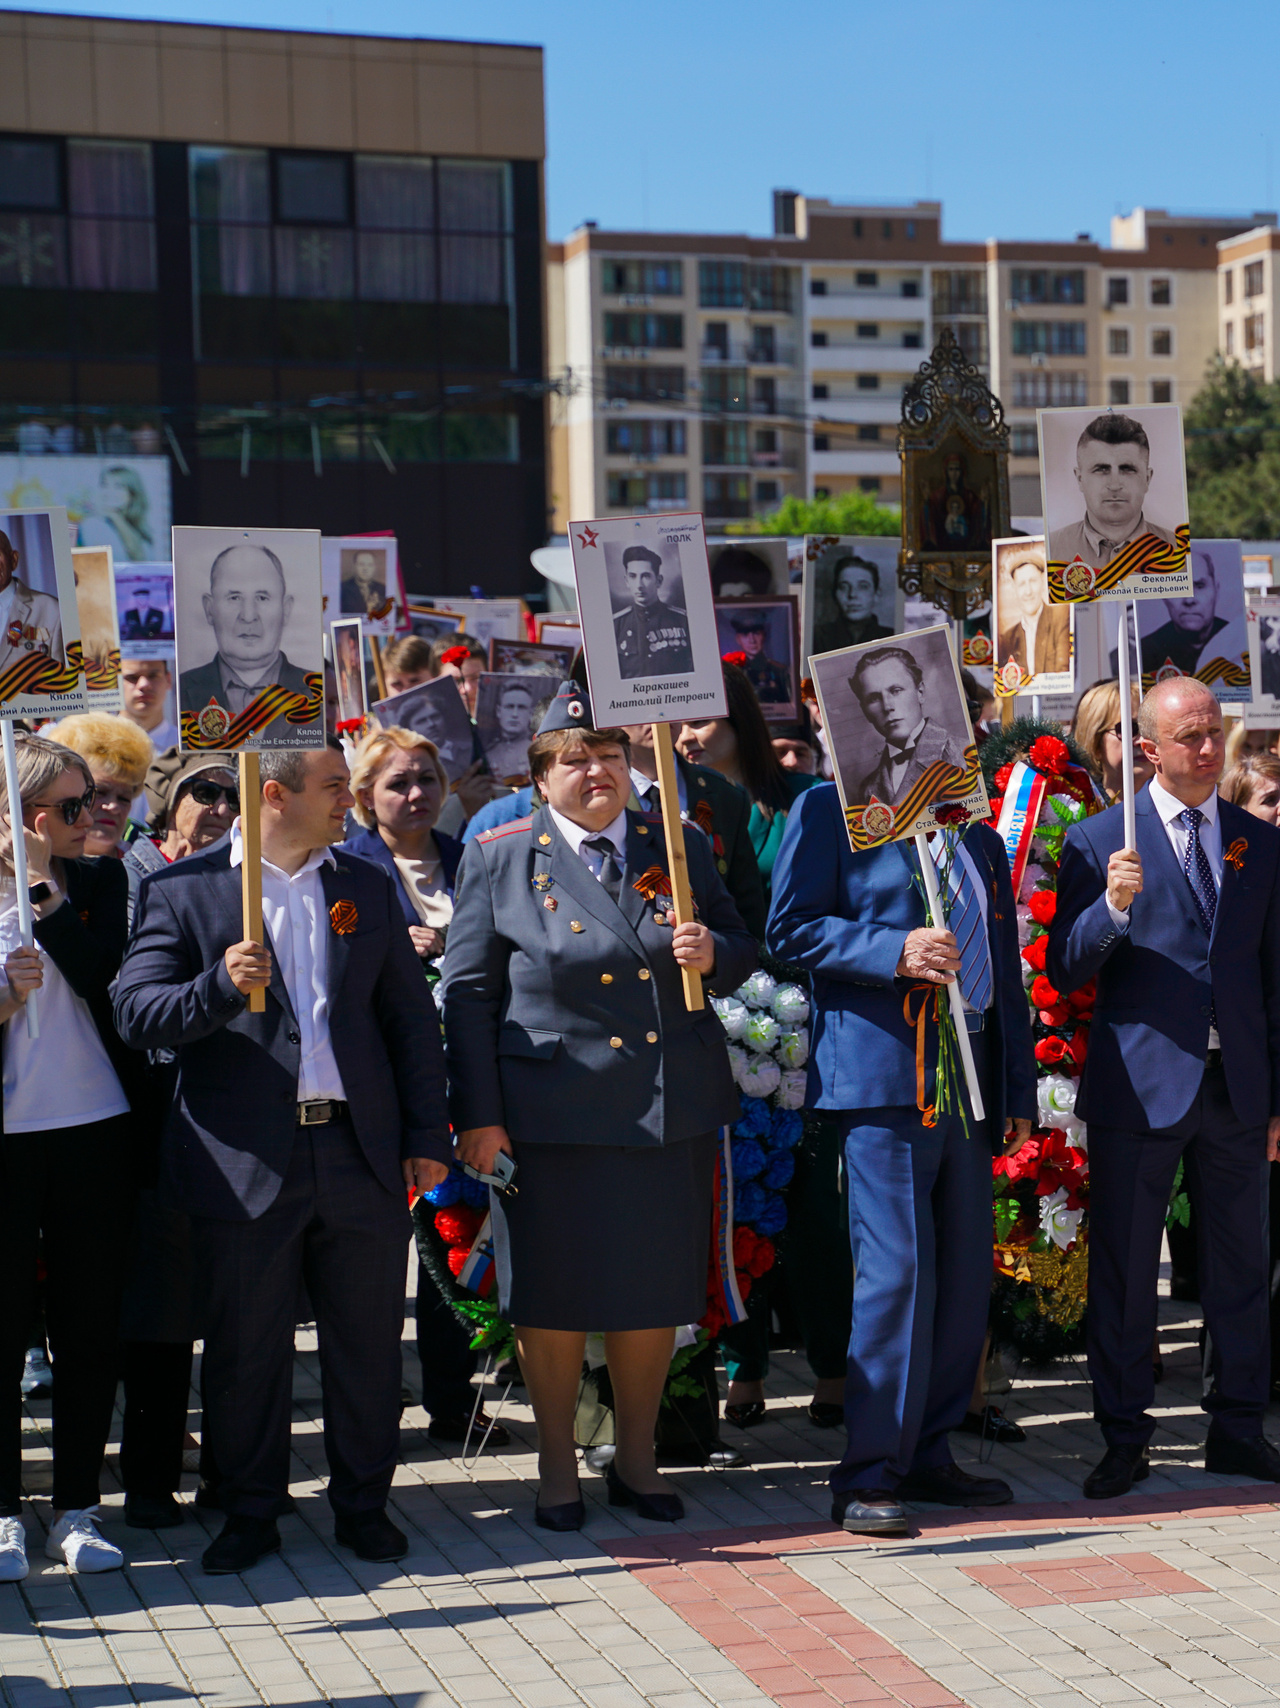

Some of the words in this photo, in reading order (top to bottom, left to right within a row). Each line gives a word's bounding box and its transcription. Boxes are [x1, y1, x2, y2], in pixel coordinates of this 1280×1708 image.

[666, 534, 692, 543] ПОЛК
[1142, 575, 1188, 583] Фекелиди
[1095, 587, 1131, 596] Николай
[1134, 585, 1189, 594] Евстафьевич
[632, 680, 690, 694] Каракашев
[49, 691, 83, 701] Кялов
[609, 695, 662, 710] Анатолий
[664, 691, 715, 704] Петрович
[20, 703, 85, 714] Аверьянович
[296, 728, 322, 736] Кялов
[244, 737, 272, 745] Авраам
[273, 737, 323, 746] Евстафьевич
